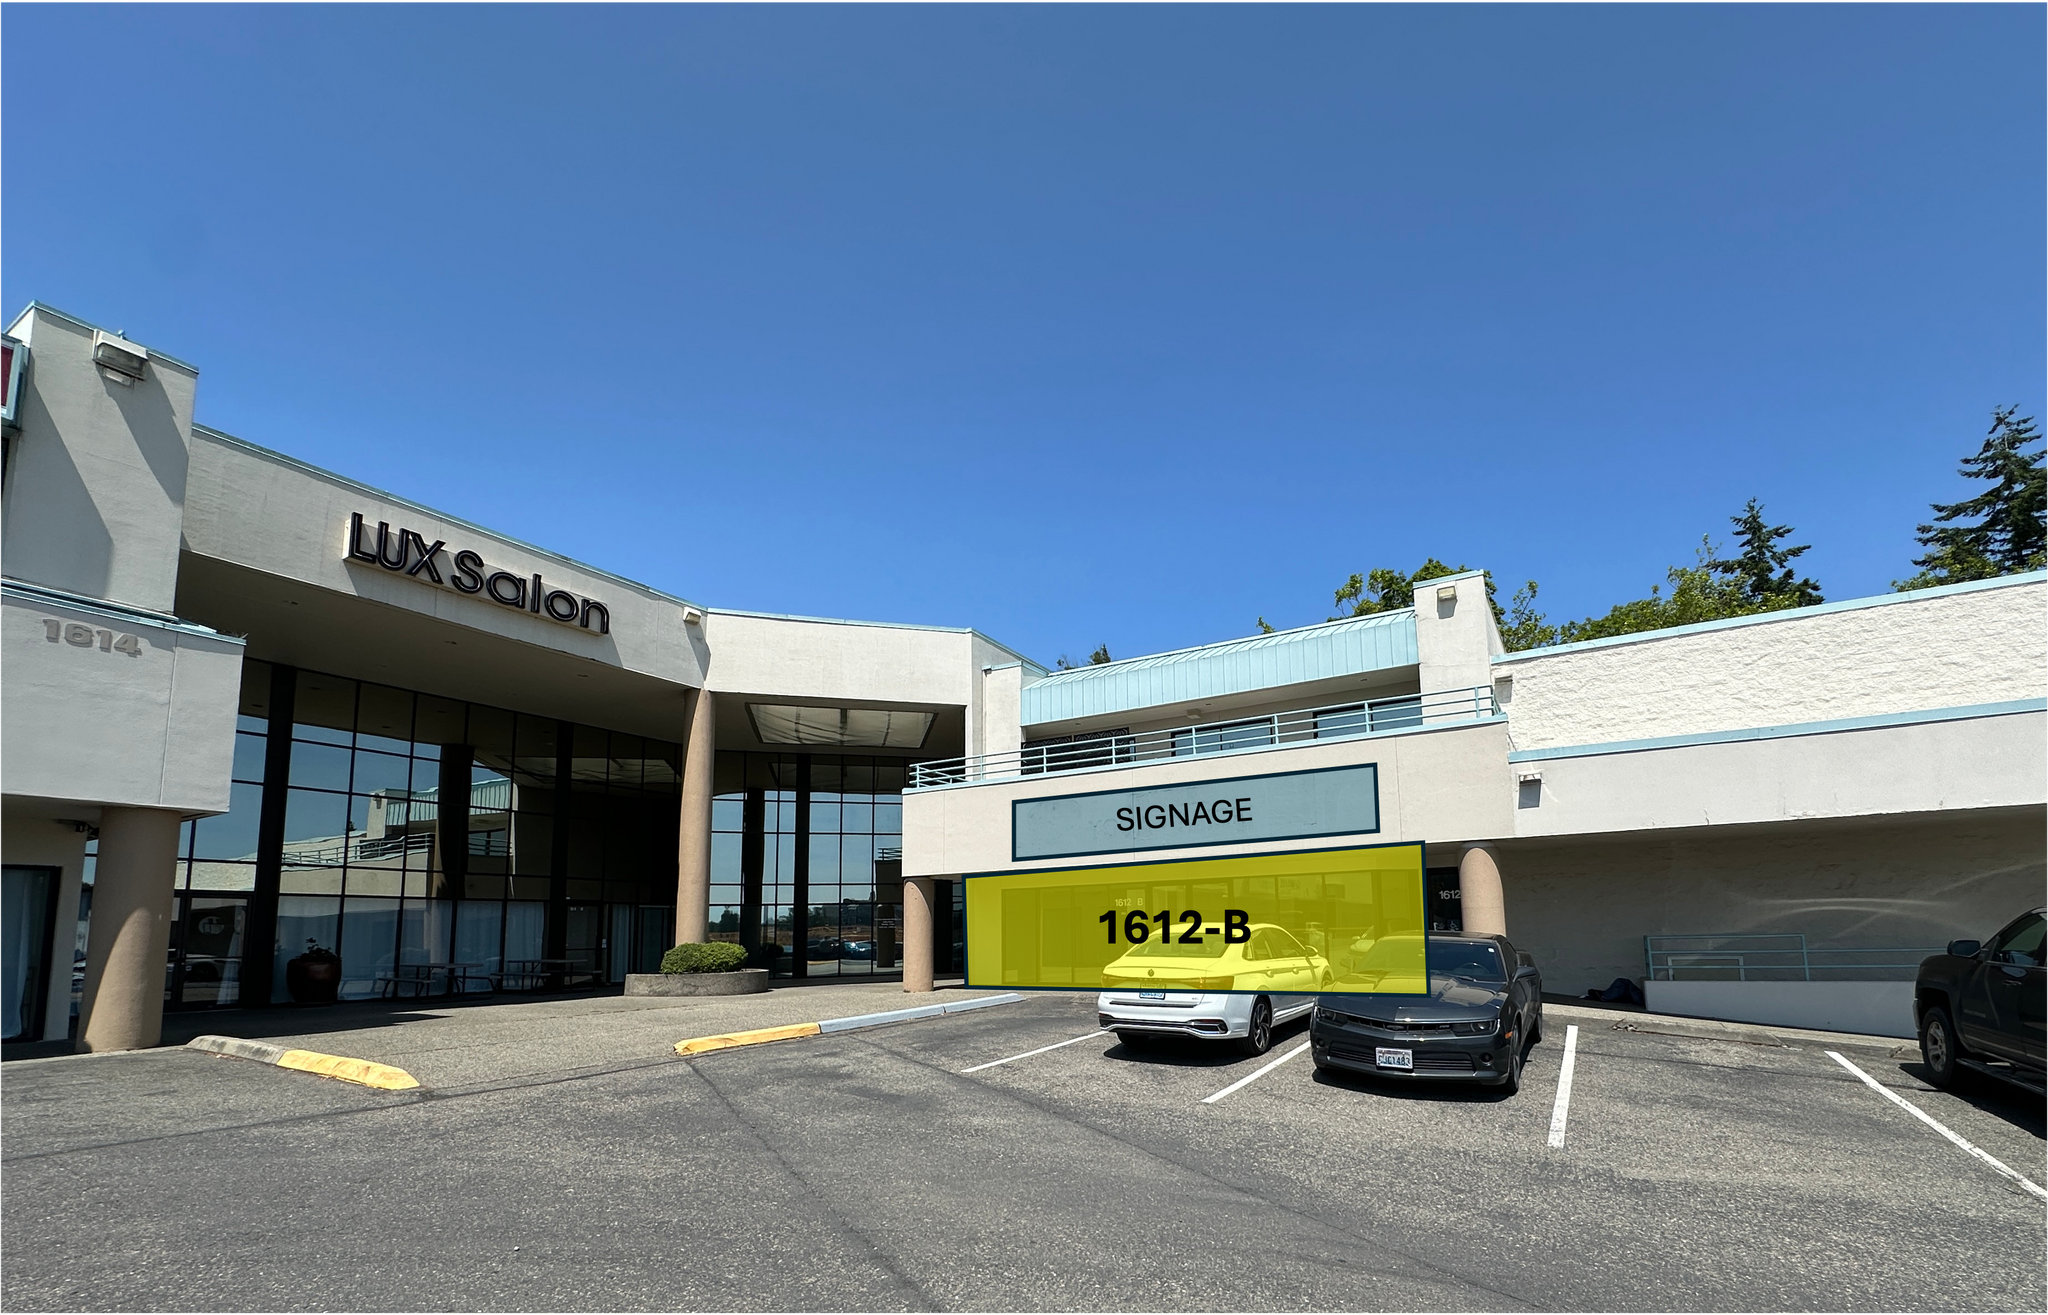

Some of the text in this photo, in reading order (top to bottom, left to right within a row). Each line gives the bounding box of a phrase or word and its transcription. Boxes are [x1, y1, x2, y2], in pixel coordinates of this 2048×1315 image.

[349, 511, 611, 634] LUX Salon
[42, 618, 143, 658] 1614
[1114, 897, 1144, 907] 1612 B
[1439, 889, 1461, 900] 1612
